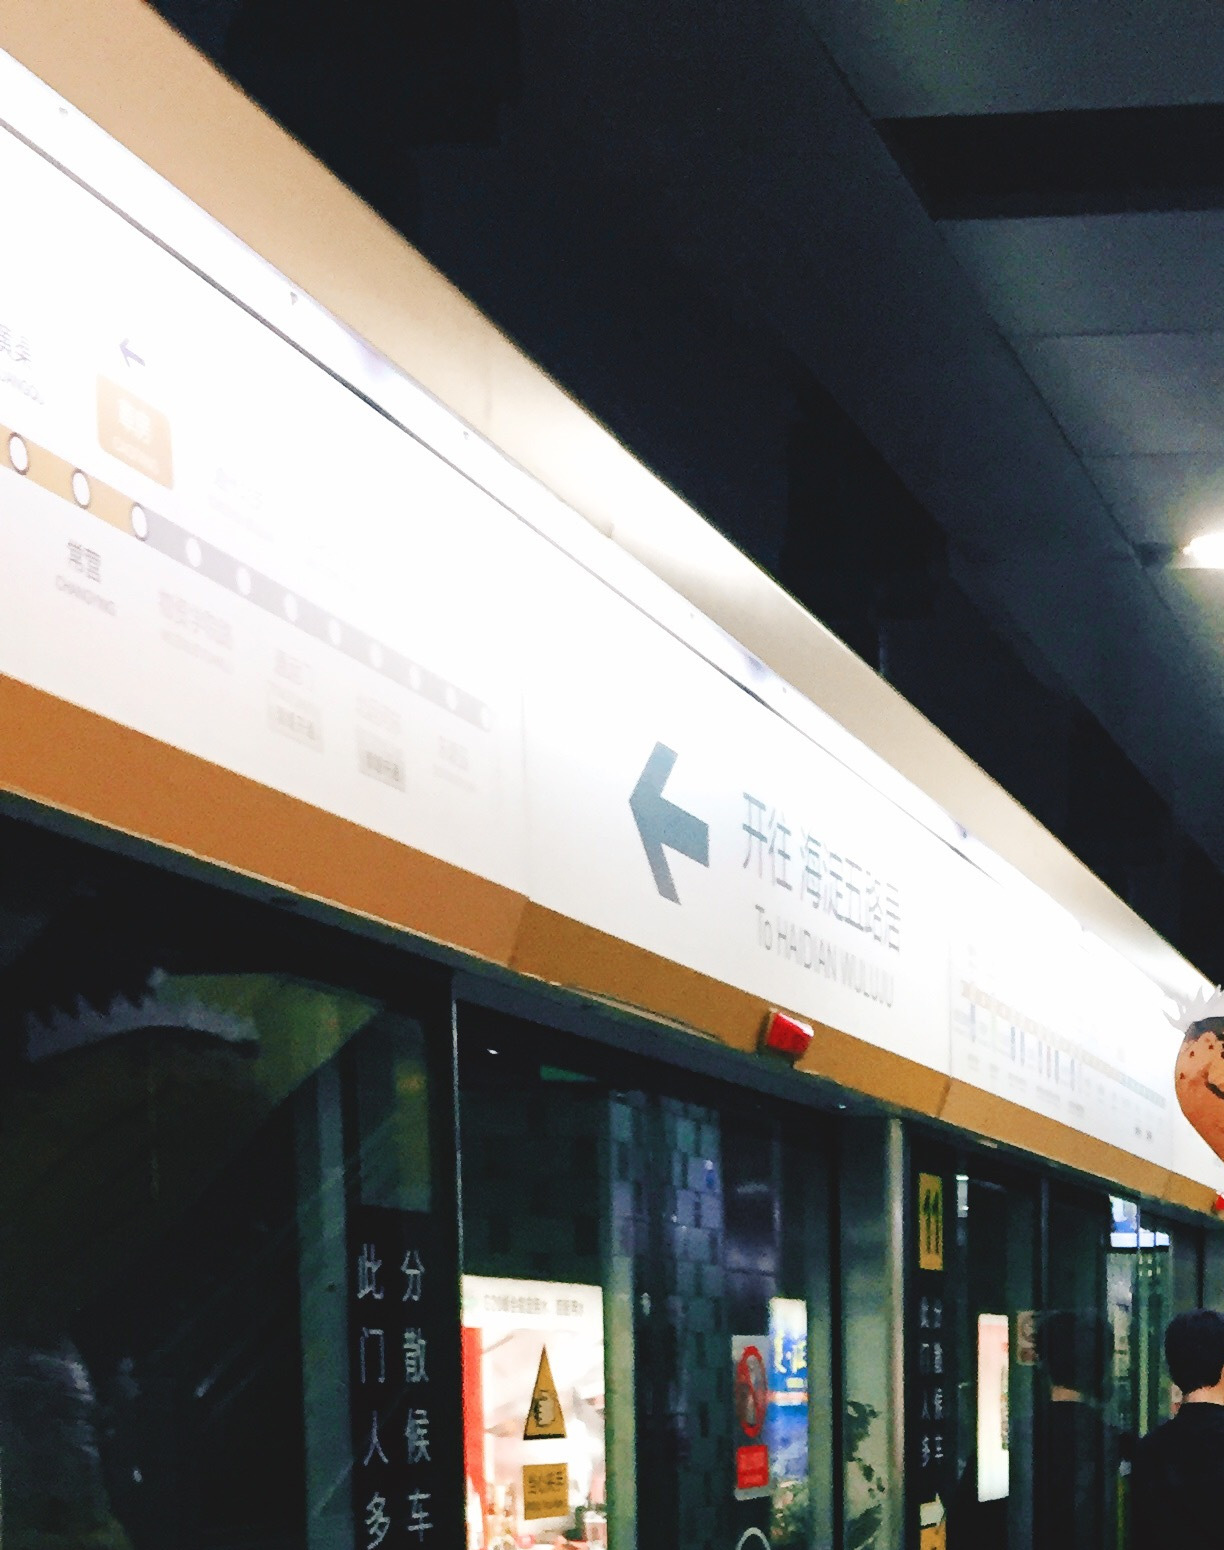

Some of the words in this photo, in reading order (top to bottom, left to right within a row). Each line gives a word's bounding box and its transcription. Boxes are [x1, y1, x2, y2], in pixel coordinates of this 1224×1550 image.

[755, 903, 773, 951] To
[357, 1243, 390, 1550] 此门人多
[401, 1250, 433, 1542] 分散候车
